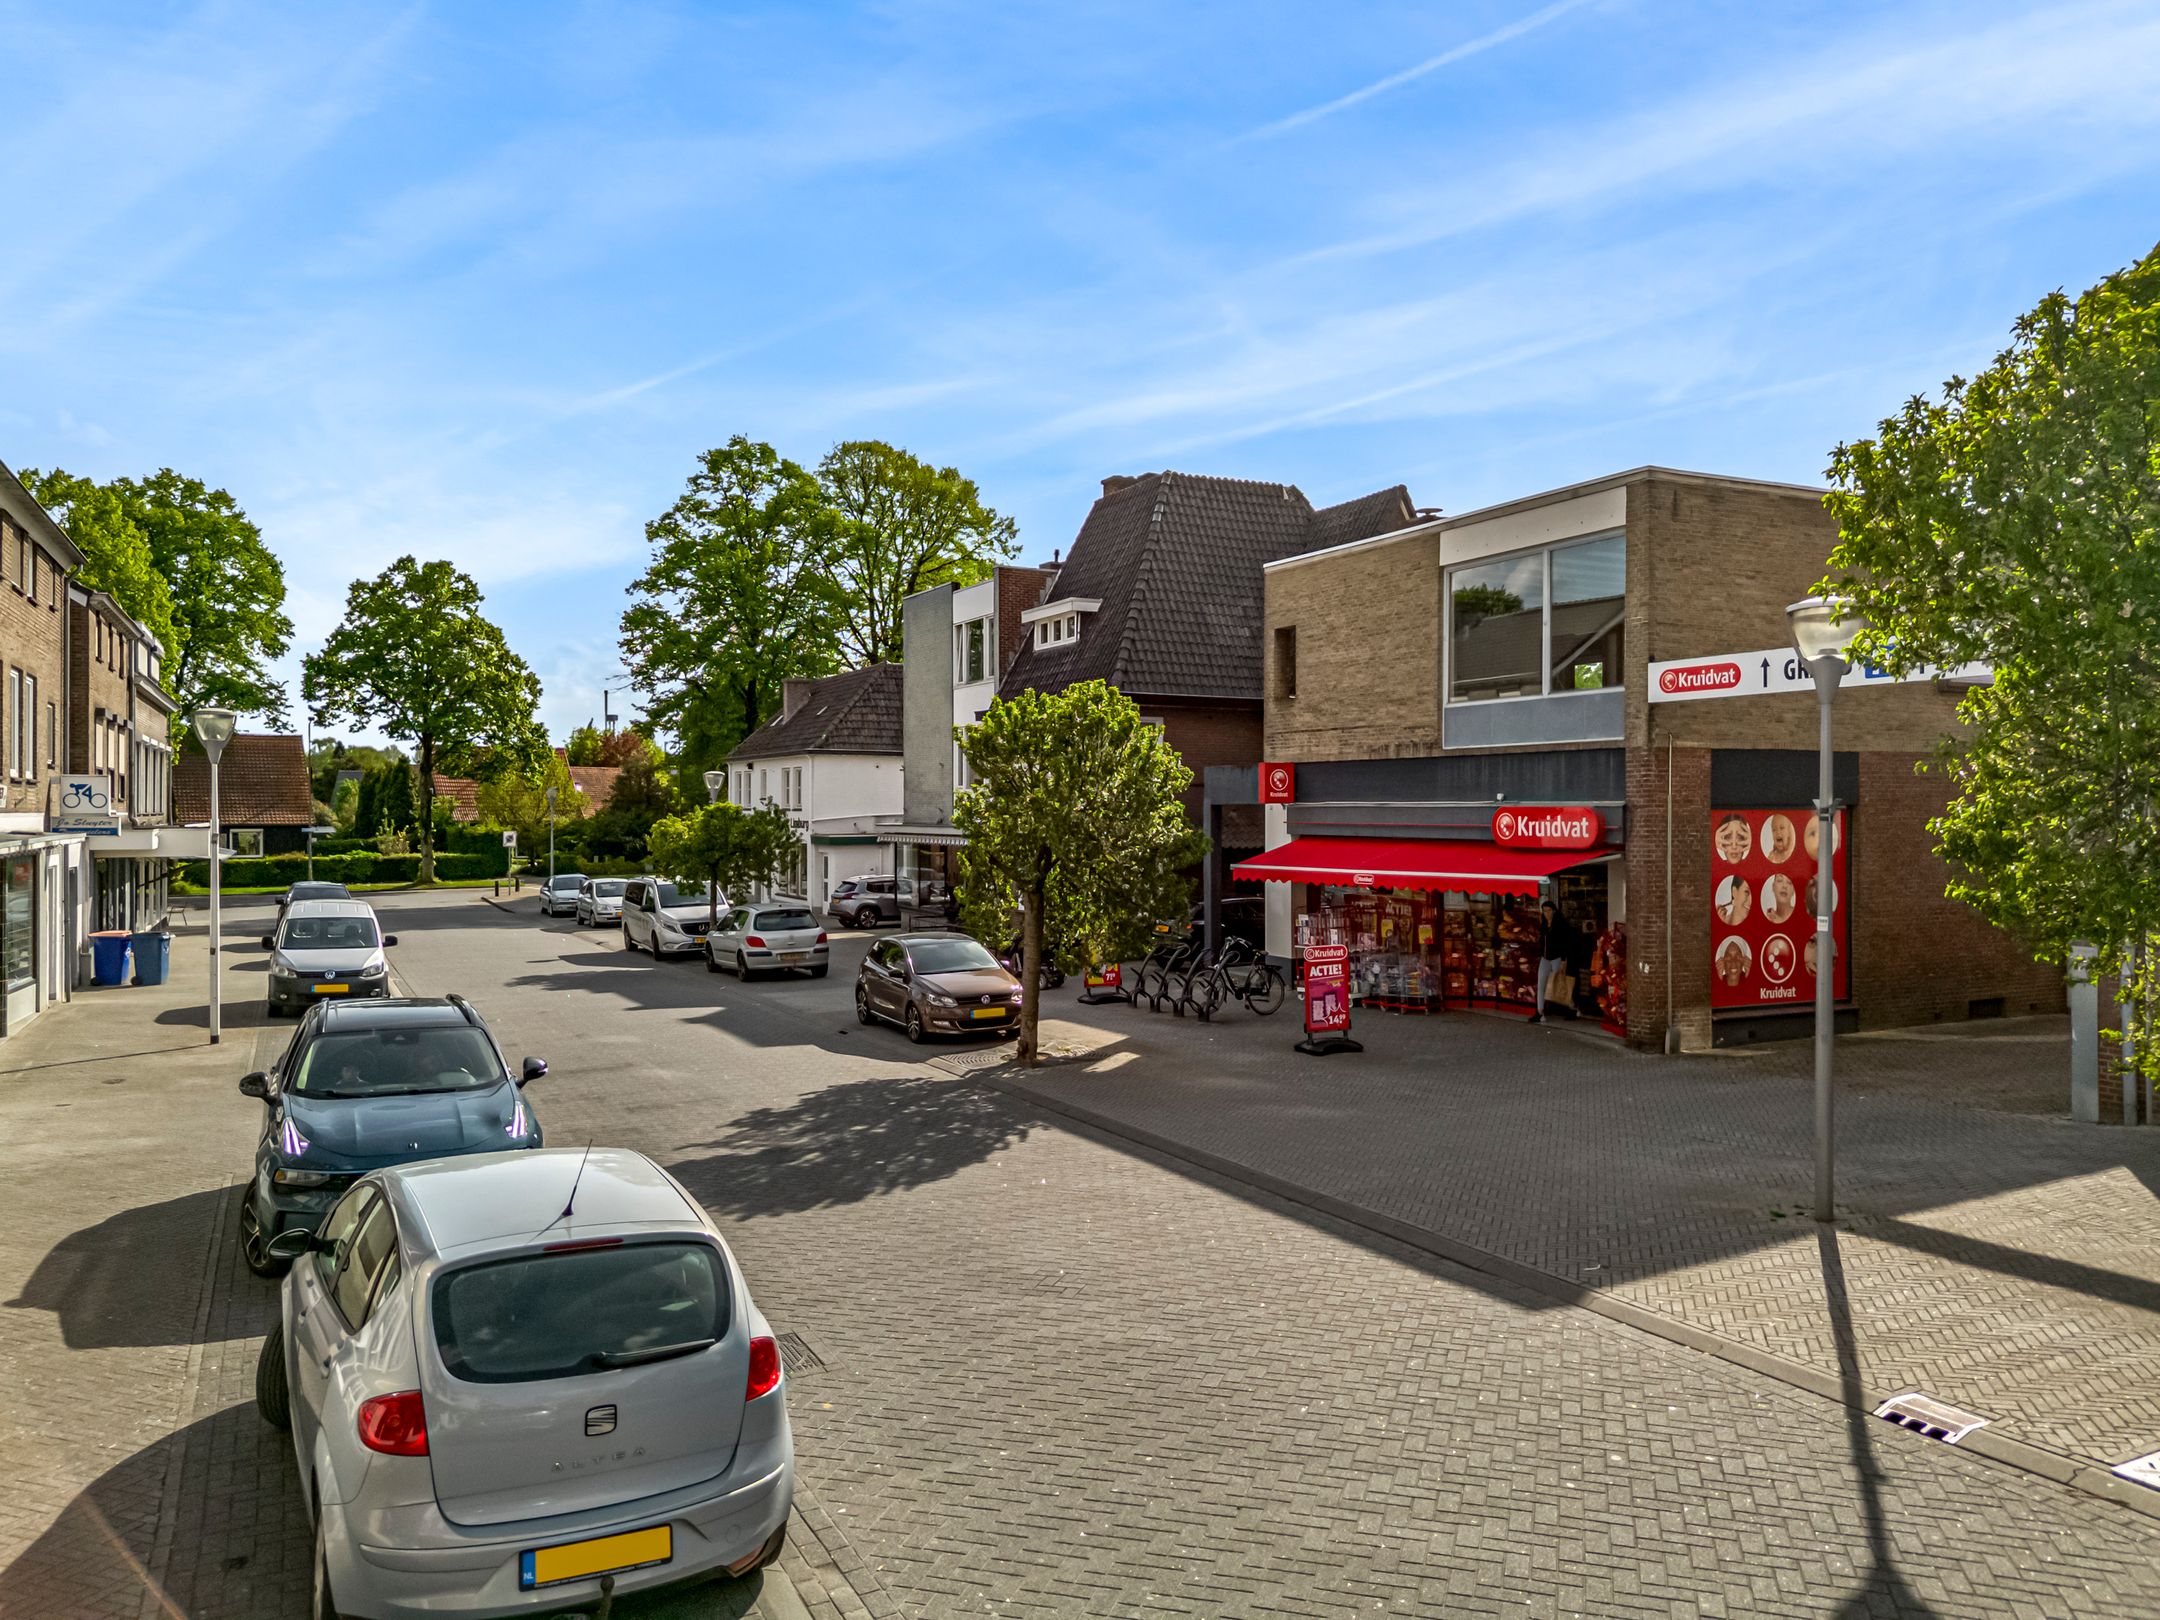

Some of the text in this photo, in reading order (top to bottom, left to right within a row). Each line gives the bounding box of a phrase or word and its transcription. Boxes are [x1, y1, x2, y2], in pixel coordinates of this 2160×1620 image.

[1678, 668, 1736, 688] Kruidvat
[1517, 815, 1589, 838] Kruidvat
[1314, 948, 1344, 958] Kruidvat
[1309, 963, 1343, 977] ACTIE!
[1760, 986, 1797, 999] Kruidvat
[551, 1447, 647, 1472] ALTEA
[523, 1571, 534, 1581] NL
